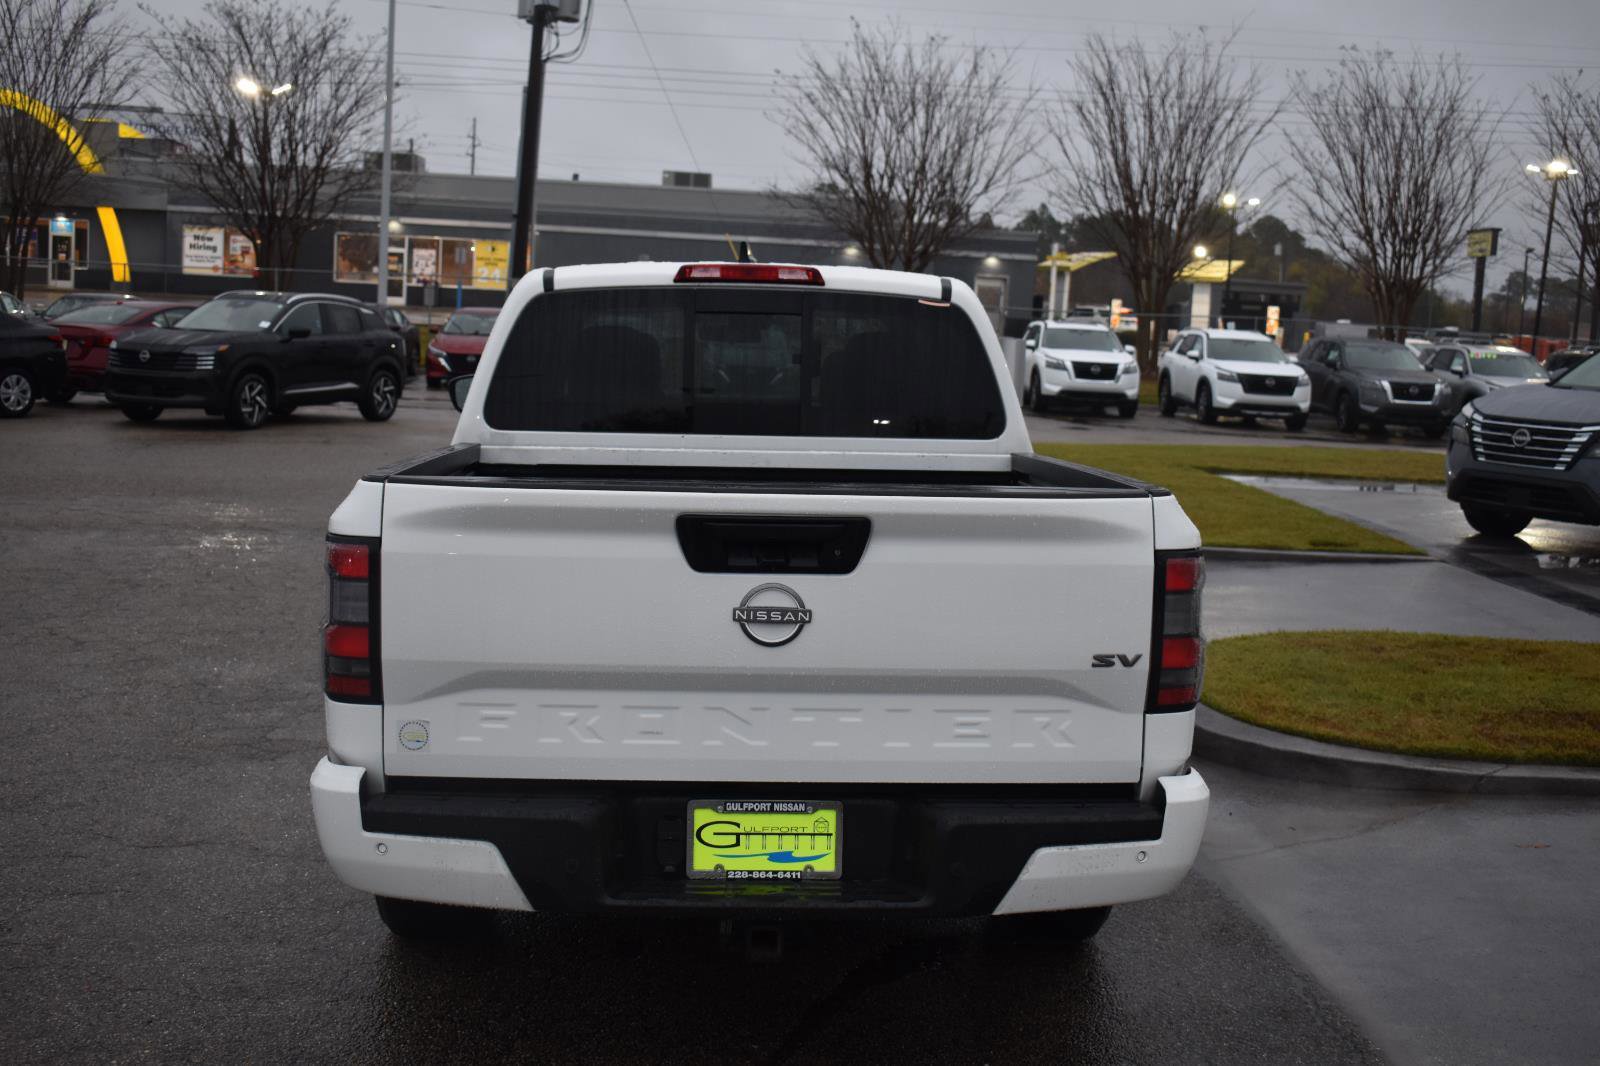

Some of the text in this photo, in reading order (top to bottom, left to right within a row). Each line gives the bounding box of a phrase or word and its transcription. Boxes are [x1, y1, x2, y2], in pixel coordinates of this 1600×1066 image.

[193, 234, 214, 242] Now
[189, 243, 218, 253] Hiring
[735, 610, 810, 621] NISSAN
[1091, 654, 1143, 668] SV
[455, 701, 1076, 750] FRONTIER
[726, 802, 806, 812] GULFPORT NISSAN
[727, 871, 801, 879] 228-864-6411
